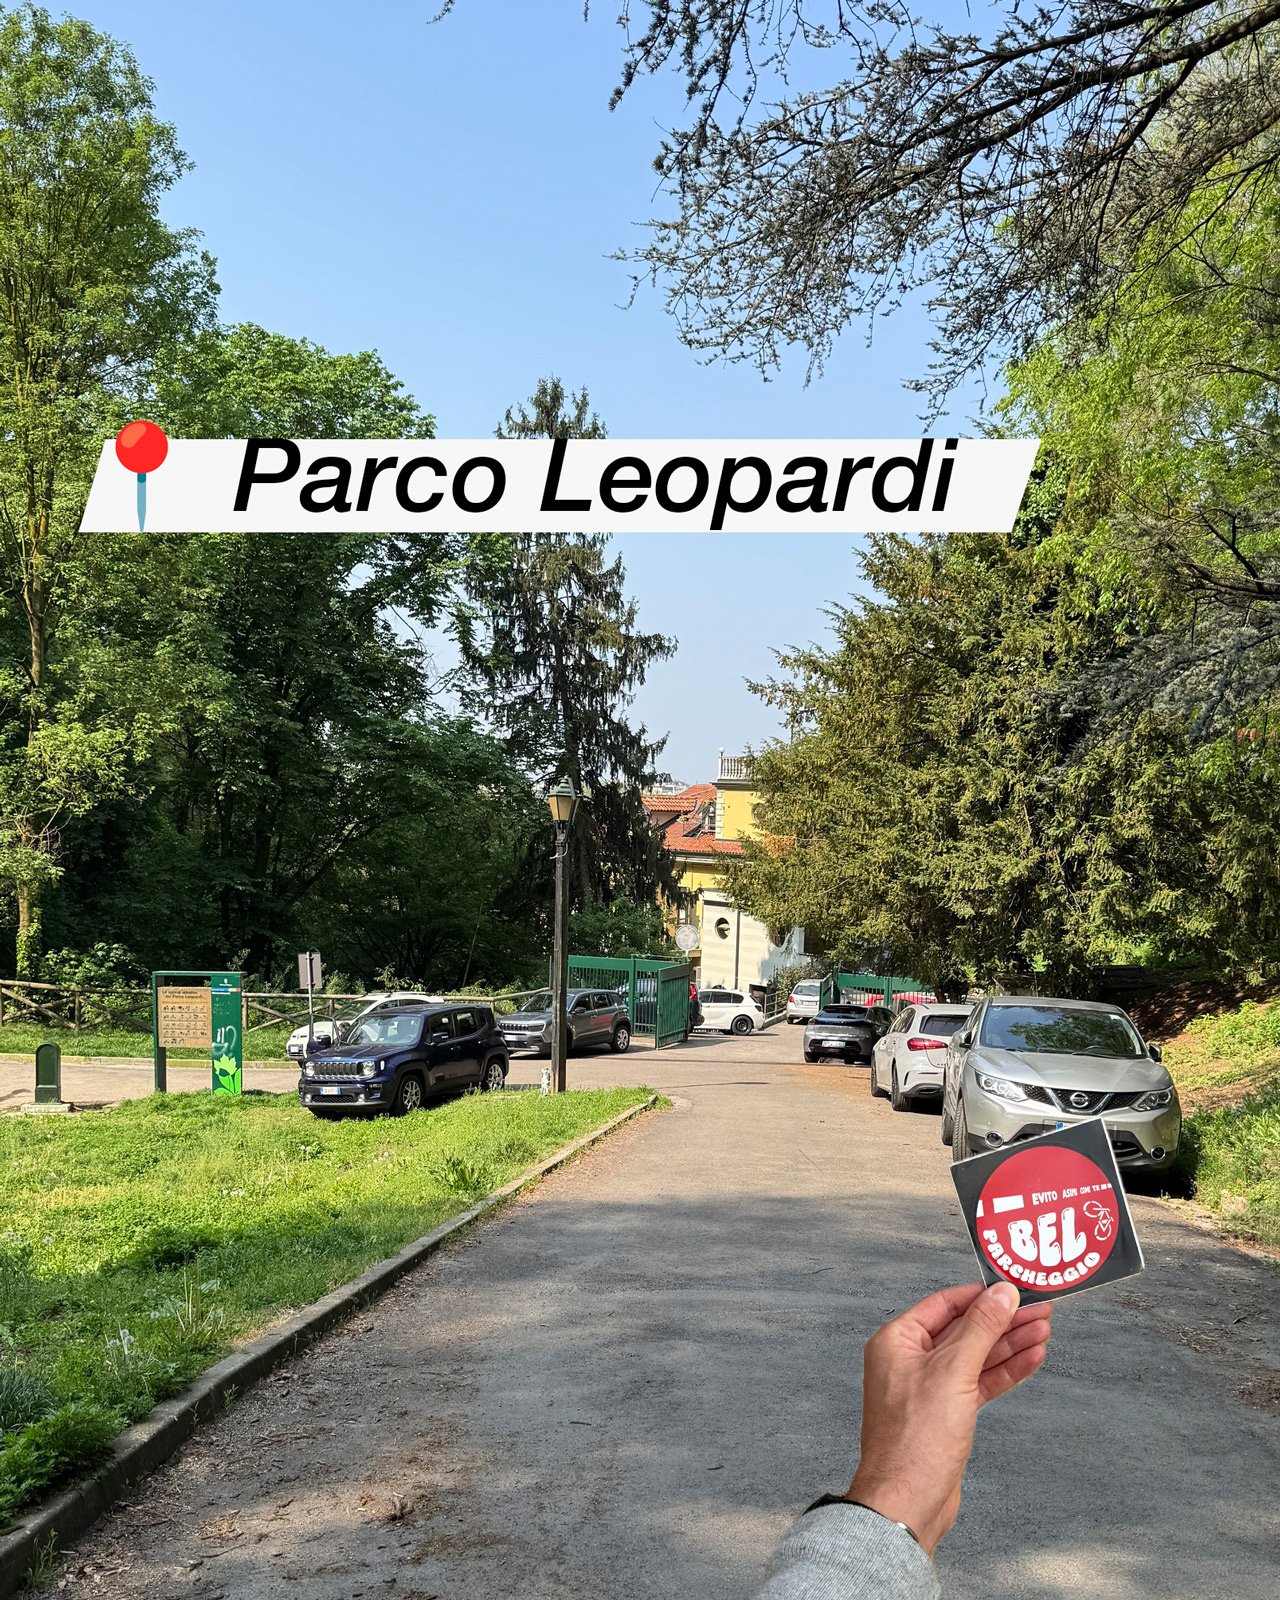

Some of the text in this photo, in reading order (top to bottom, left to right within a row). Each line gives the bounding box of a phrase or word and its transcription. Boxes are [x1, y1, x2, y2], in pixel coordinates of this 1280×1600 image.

[1031, 1191, 1058, 1206] EVITO
[982, 1229, 1101, 1286] PARCHEGGIO
[1008, 1207, 1087, 1267] BEL
